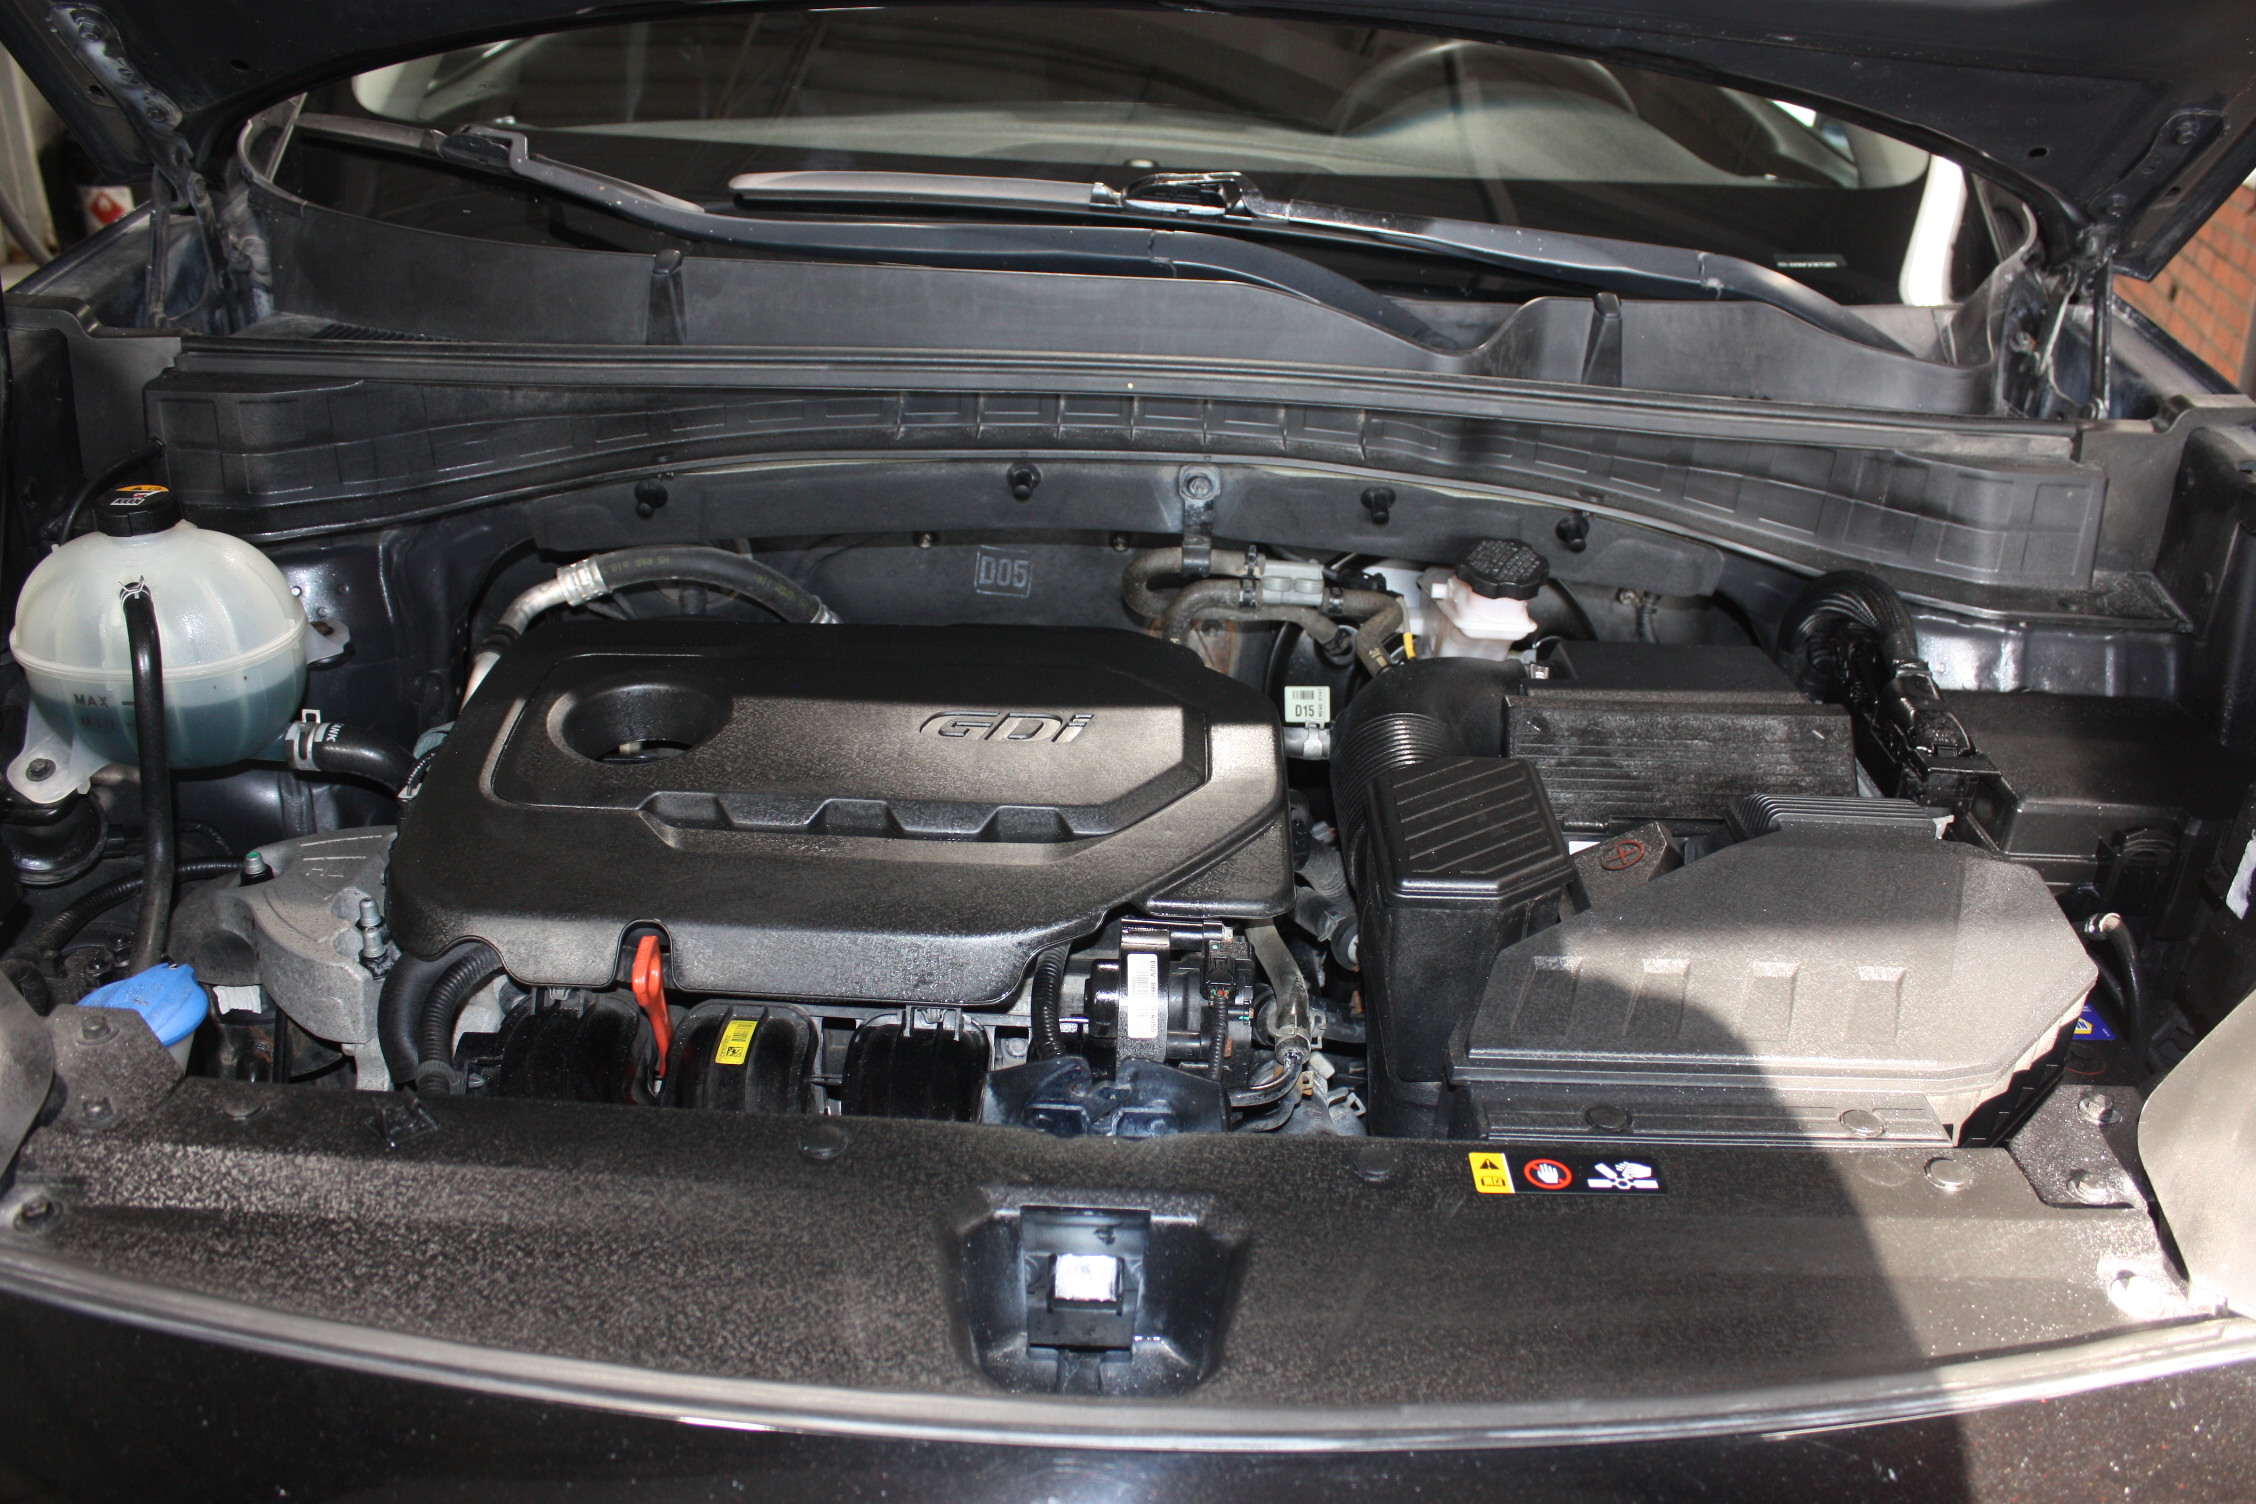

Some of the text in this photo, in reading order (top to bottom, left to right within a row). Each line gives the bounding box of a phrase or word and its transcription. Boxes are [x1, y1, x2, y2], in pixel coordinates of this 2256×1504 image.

[978, 556, 1029, 588] D05
[73, 693, 109, 708] MAX
[1295, 704, 1315, 718] D15
[919, 709, 1095, 743] GDi
